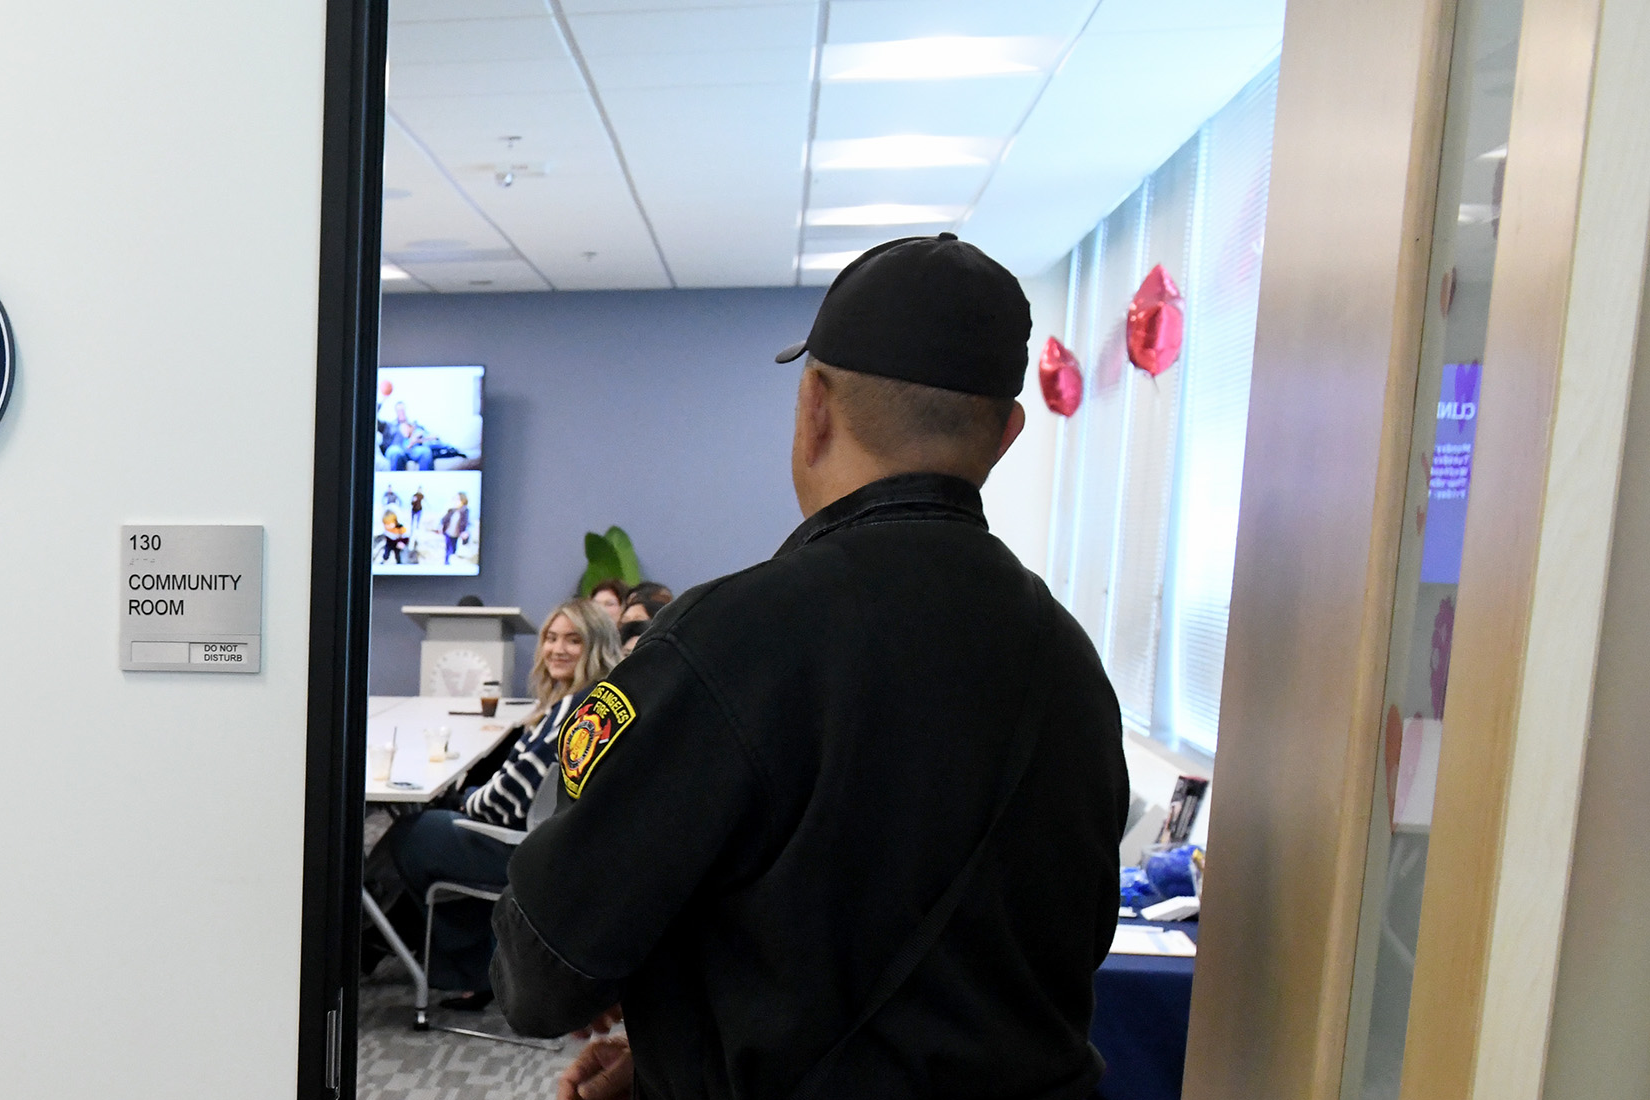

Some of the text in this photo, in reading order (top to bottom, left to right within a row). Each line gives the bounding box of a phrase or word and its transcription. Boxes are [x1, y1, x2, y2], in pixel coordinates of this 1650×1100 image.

[129, 534, 161, 551] 130
[128, 574, 242, 590] COMMUNITY
[128, 599, 184, 615] ROOM
[204, 644, 238, 652] DO NOT
[204, 654, 243, 662] DISTURB
[593, 701, 610, 719] FIRE
[602, 690, 629, 724] ANGELES
